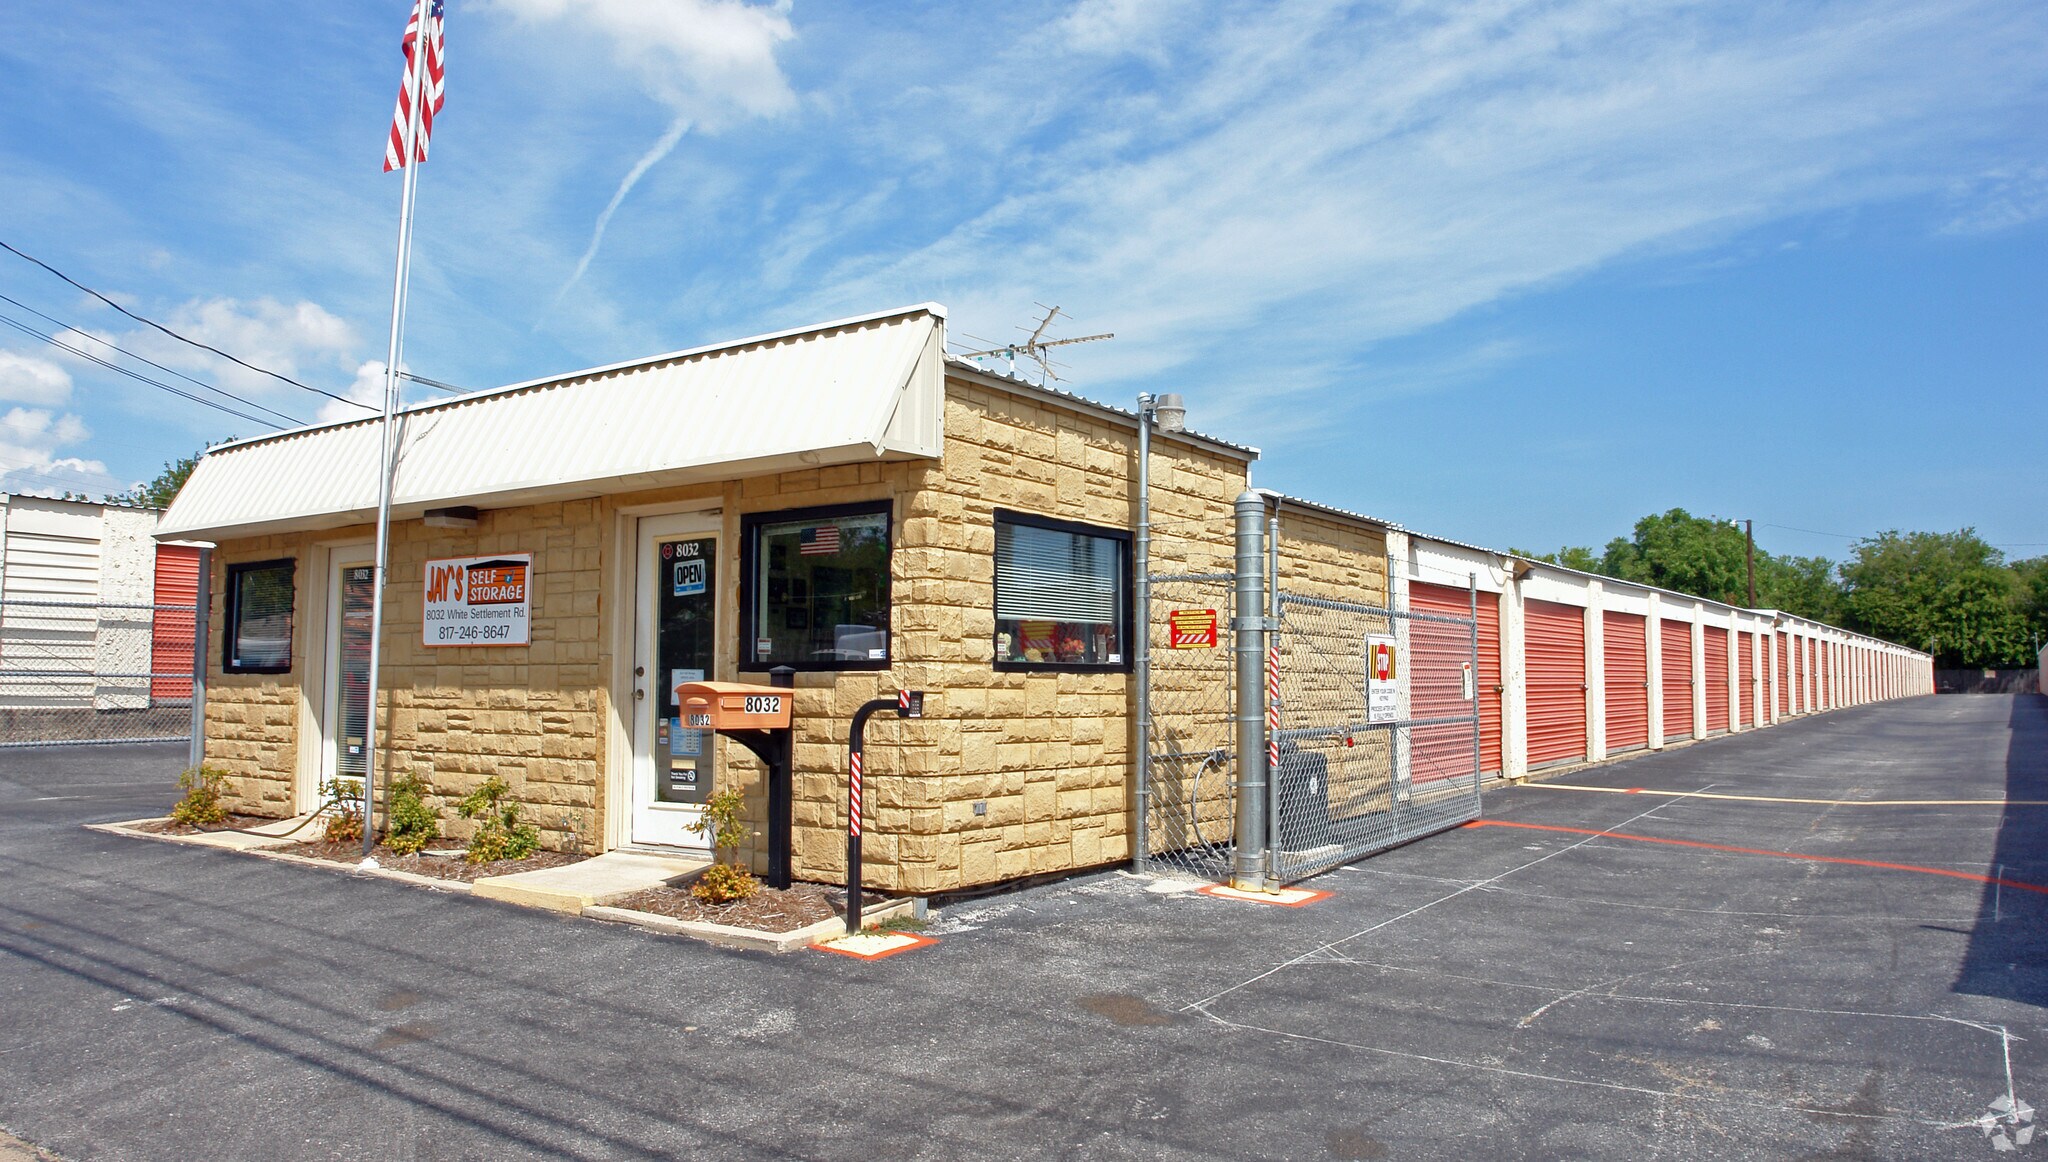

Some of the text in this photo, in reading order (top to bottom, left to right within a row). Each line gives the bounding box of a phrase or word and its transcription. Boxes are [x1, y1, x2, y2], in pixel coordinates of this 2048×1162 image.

[676, 543, 699, 557] 8032
[471, 570, 497, 585] SELF
[677, 563, 702, 585] OPEN
[427, 565, 463, 603] JAY'S
[470, 585, 522, 601] STORAGE
[426, 607, 526, 620] 8032 White Settlement Rd.
[439, 625, 510, 639] 817-246-8647
[1377, 653, 1389, 672] STOP
[746, 697, 780, 713] 8032
[690, 714, 710, 726] 8032
